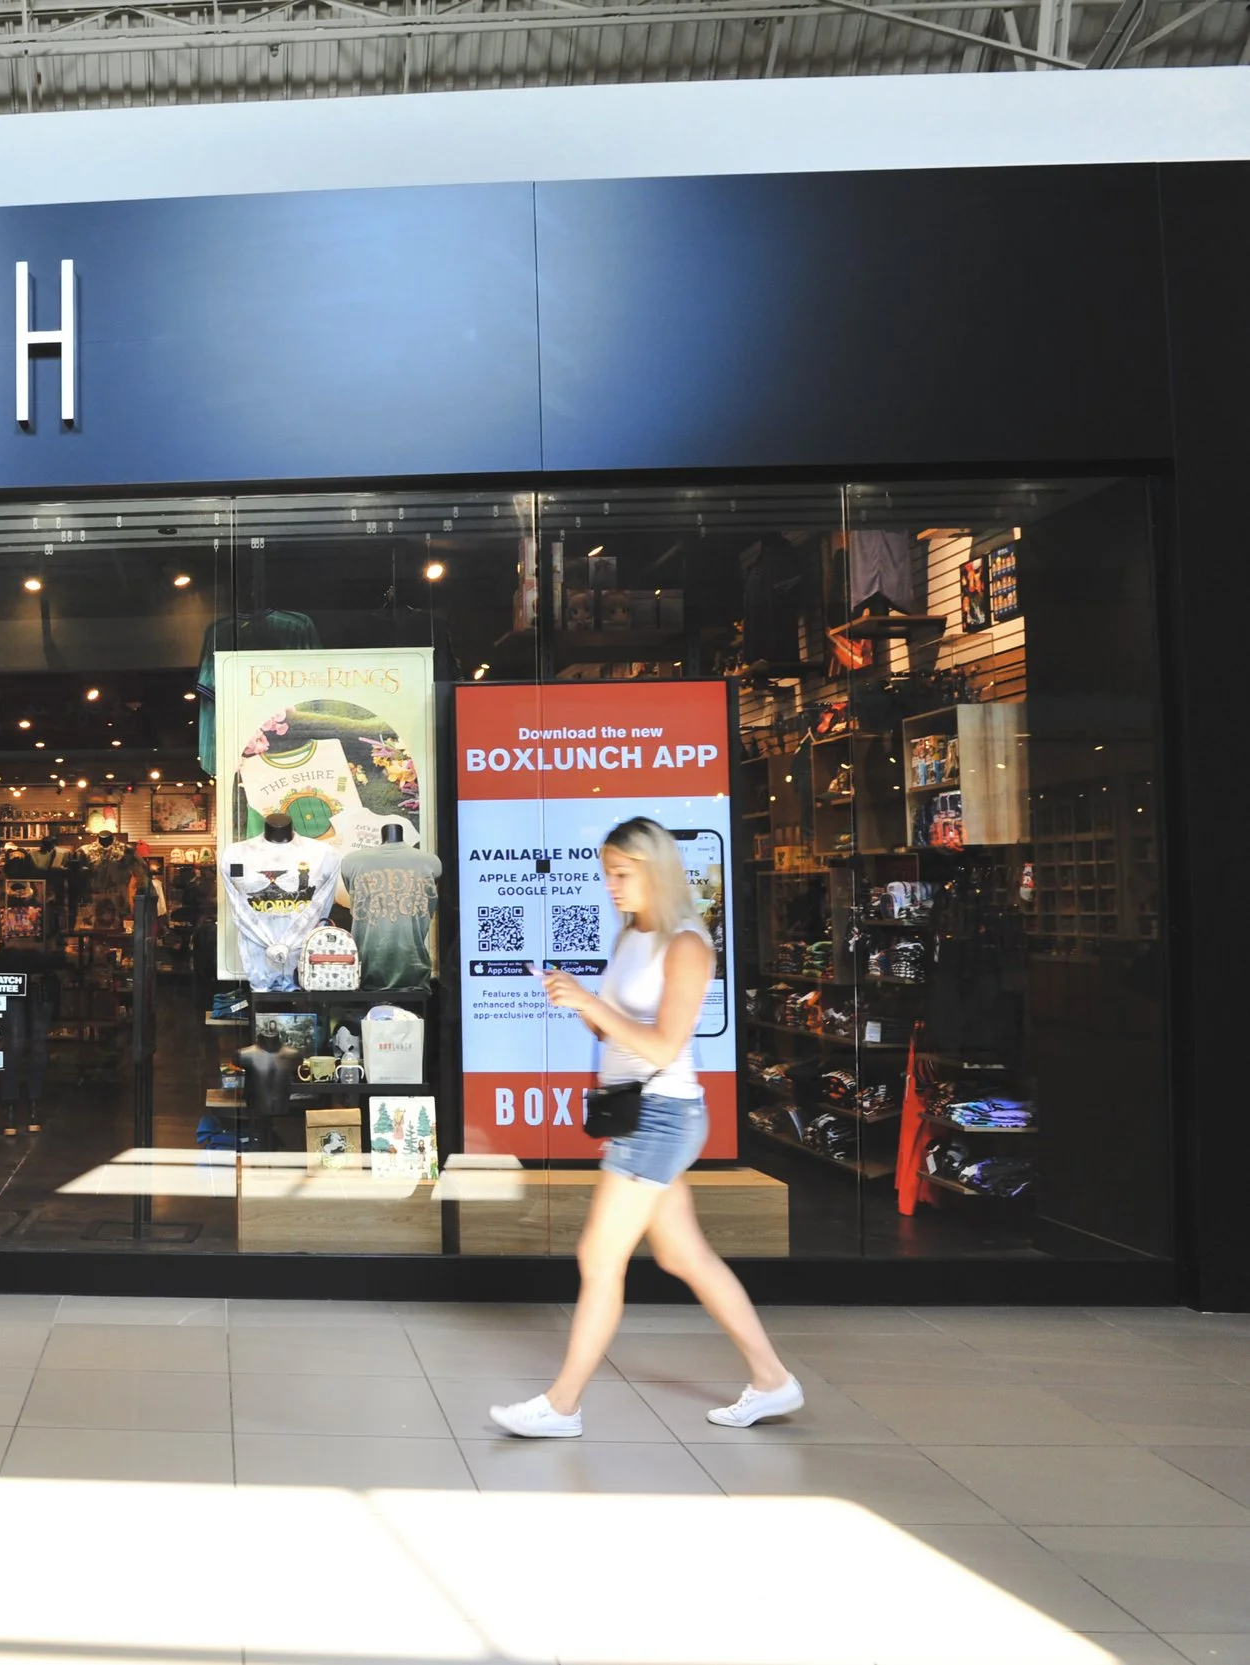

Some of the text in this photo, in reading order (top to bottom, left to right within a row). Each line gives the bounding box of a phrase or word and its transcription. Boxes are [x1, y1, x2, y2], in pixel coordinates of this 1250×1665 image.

[249, 665, 306, 697] LORD
[326, 667, 400, 695] RINGS
[518, 726, 664, 740] Download the new
[466, 745, 719, 772] BOXLUNCH APP
[260, 769, 336, 796] THE SHIRE
[469, 848, 563, 861] AVAILABLE
[479, 872, 601, 882] APPLE APP STORE &
[497, 886, 582, 896] GOOGLE PLAY
[487, 966, 523, 975] App Store
[560, 965, 599, 974] Google Play
[482, 990, 521, 998] Features
[472, 1001, 516, 1009] enhanced
[473, 1011, 536, 1020] app-exclusive
[567, 1011, 581, 1019] an
